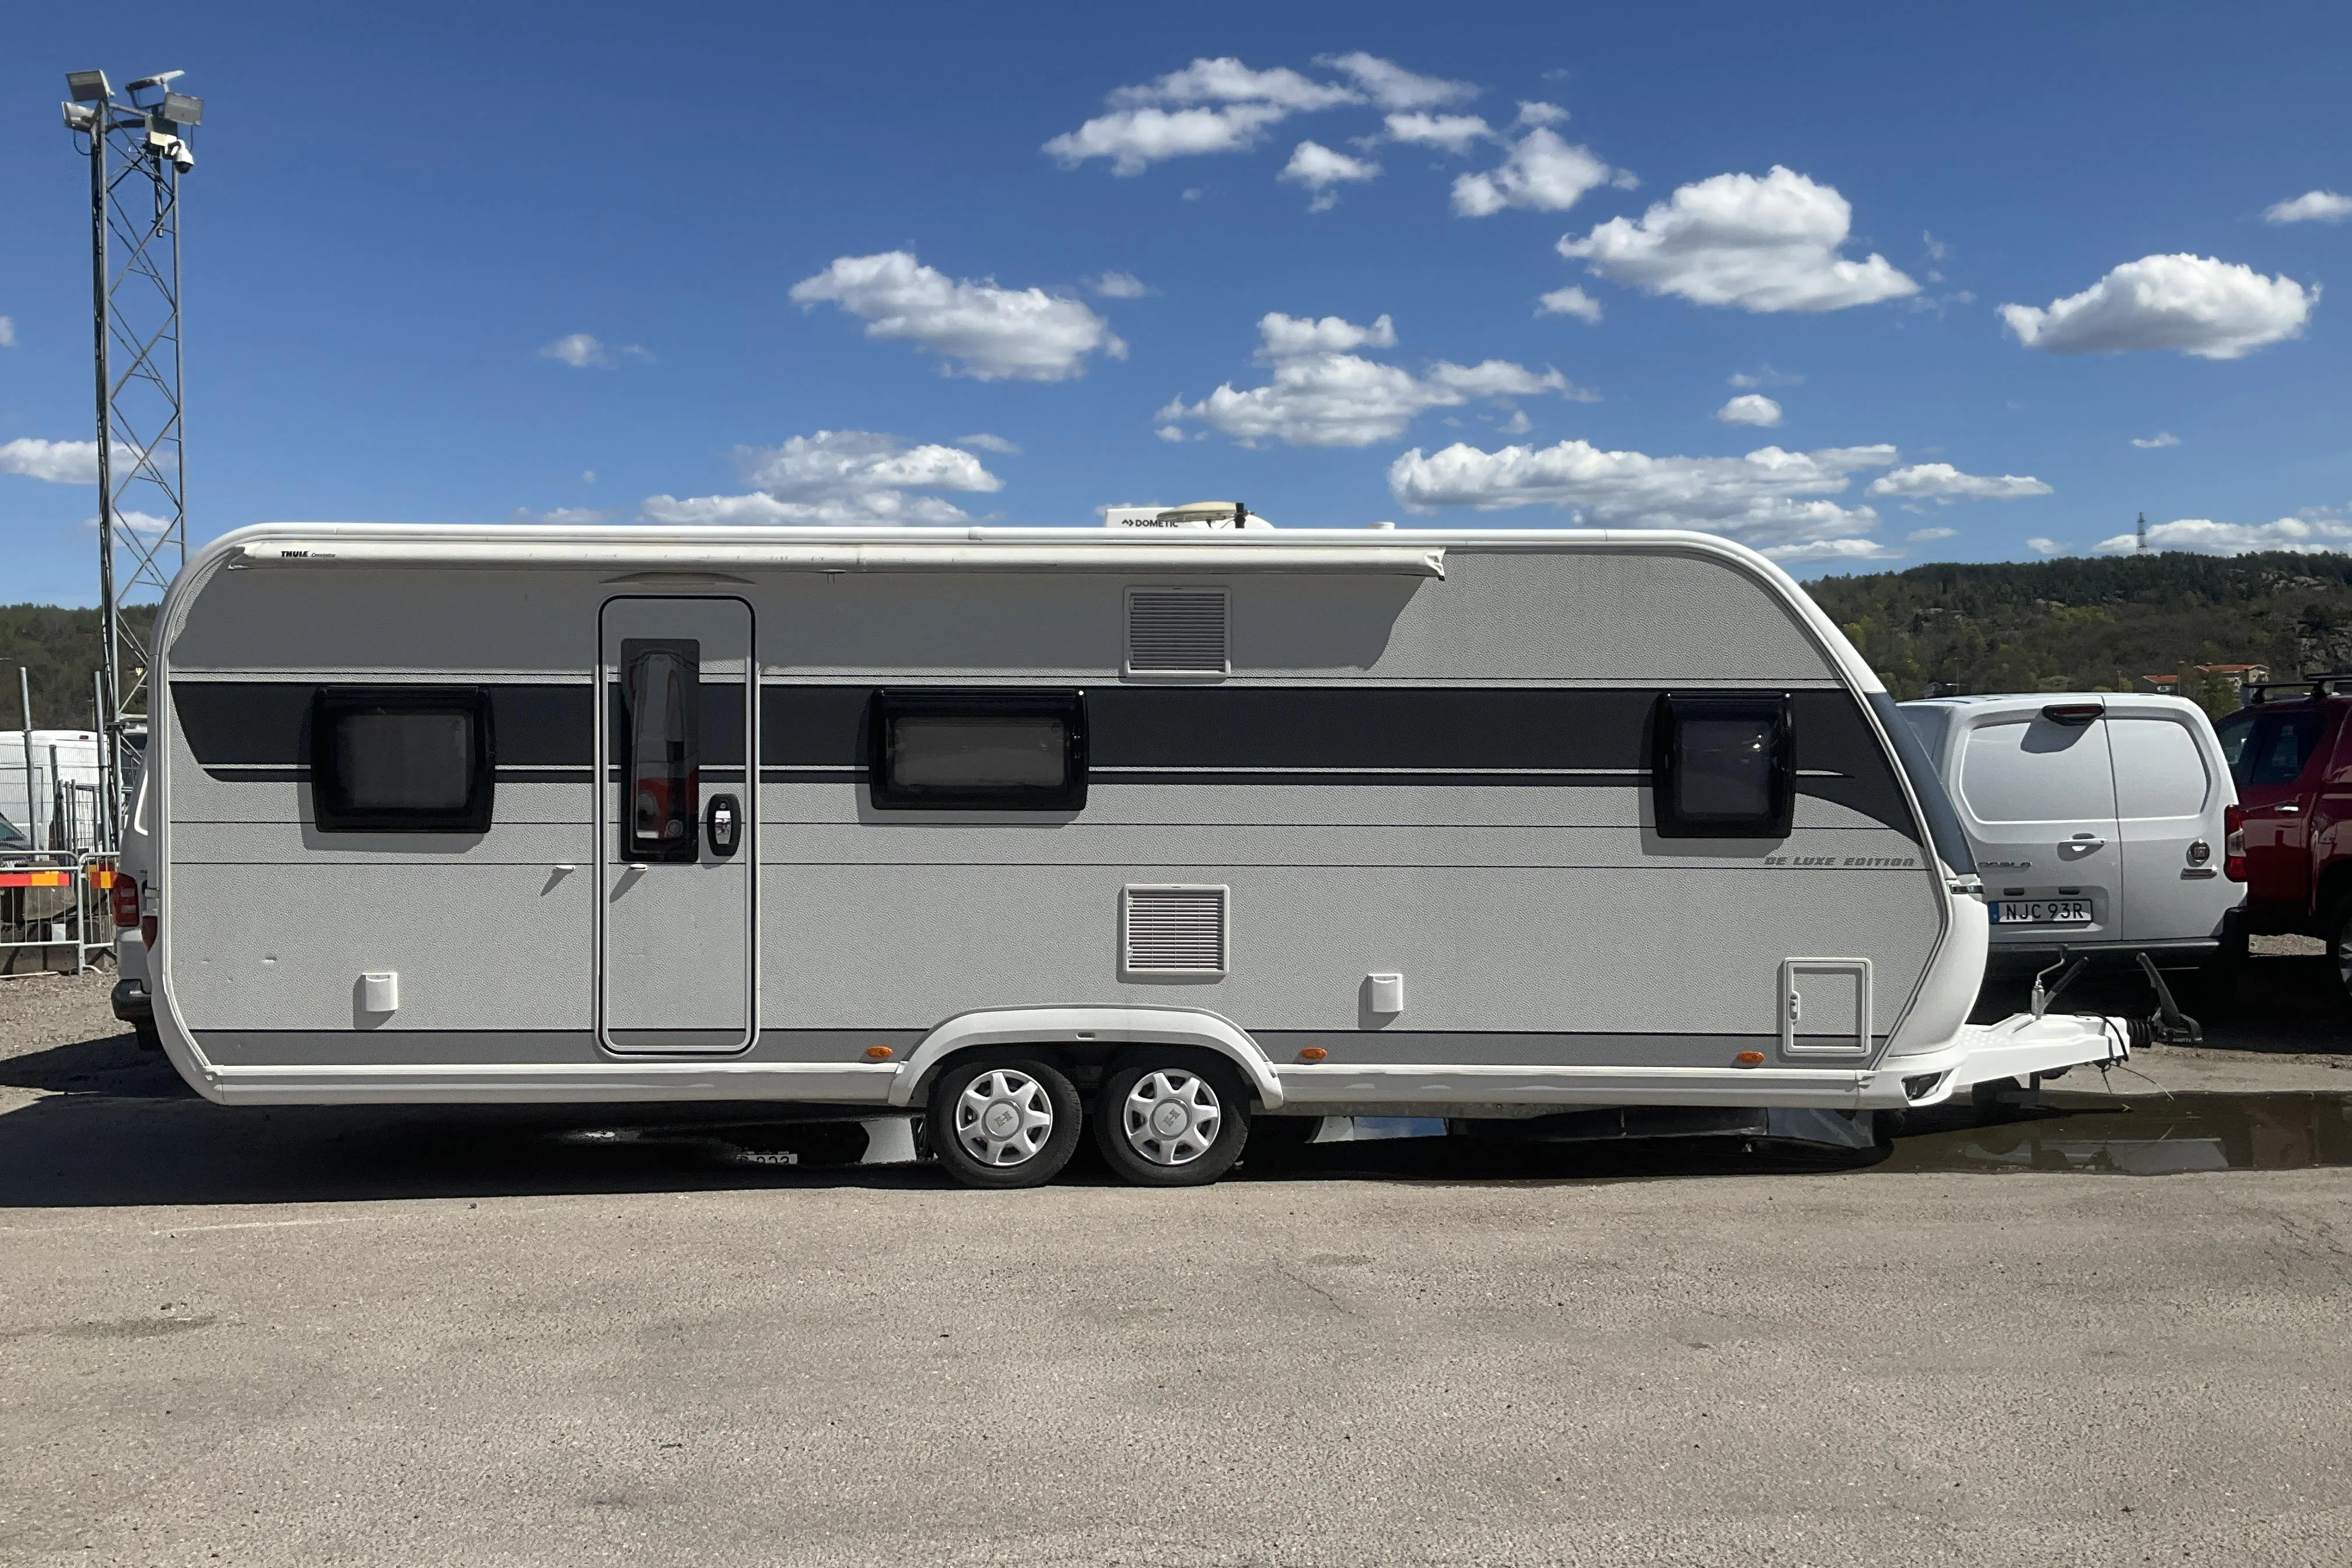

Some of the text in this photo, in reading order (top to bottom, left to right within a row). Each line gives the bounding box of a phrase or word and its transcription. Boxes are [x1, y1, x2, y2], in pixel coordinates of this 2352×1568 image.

[1764, 857, 1915, 866] DE LUXE EDITION
[2006, 903, 2084, 920] NJC 93R
